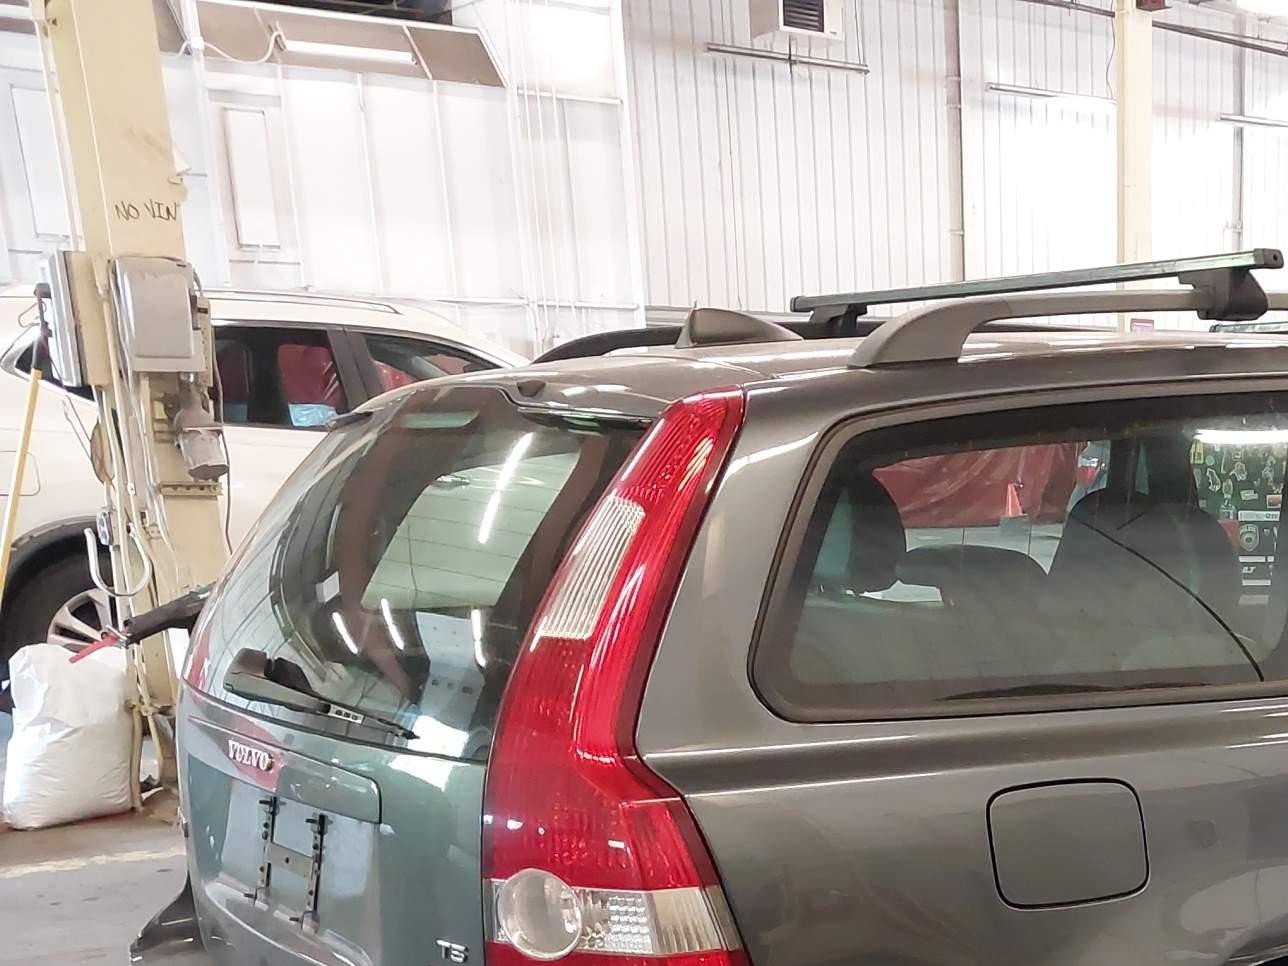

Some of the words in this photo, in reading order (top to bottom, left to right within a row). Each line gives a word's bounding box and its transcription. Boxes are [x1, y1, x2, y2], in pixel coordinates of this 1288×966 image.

[114, 200, 140, 221] NO
[143, 198, 177, 221] VIN
[228, 739, 270, 771] VOLVO
